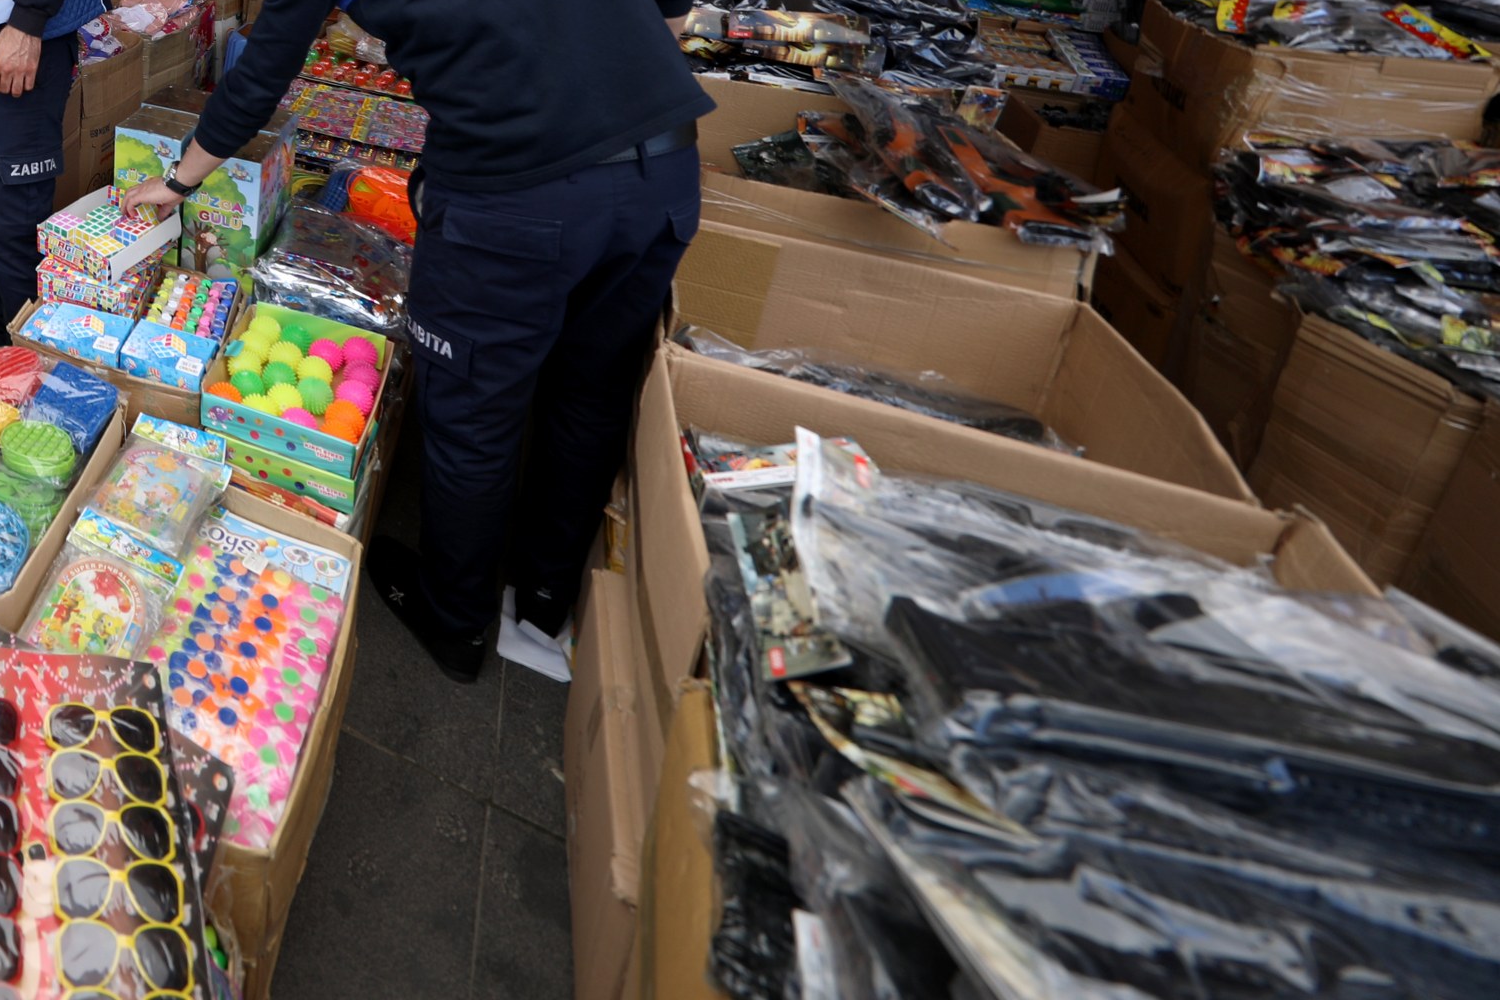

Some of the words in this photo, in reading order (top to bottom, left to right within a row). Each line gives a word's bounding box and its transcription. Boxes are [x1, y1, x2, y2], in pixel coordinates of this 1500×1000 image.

[10, 158, 57, 177] ZABITA
[198, 210, 243, 231] GÜLÜ
[53, 277, 97, 297] MAGIC
[69, 563, 97, 577] SUPER
